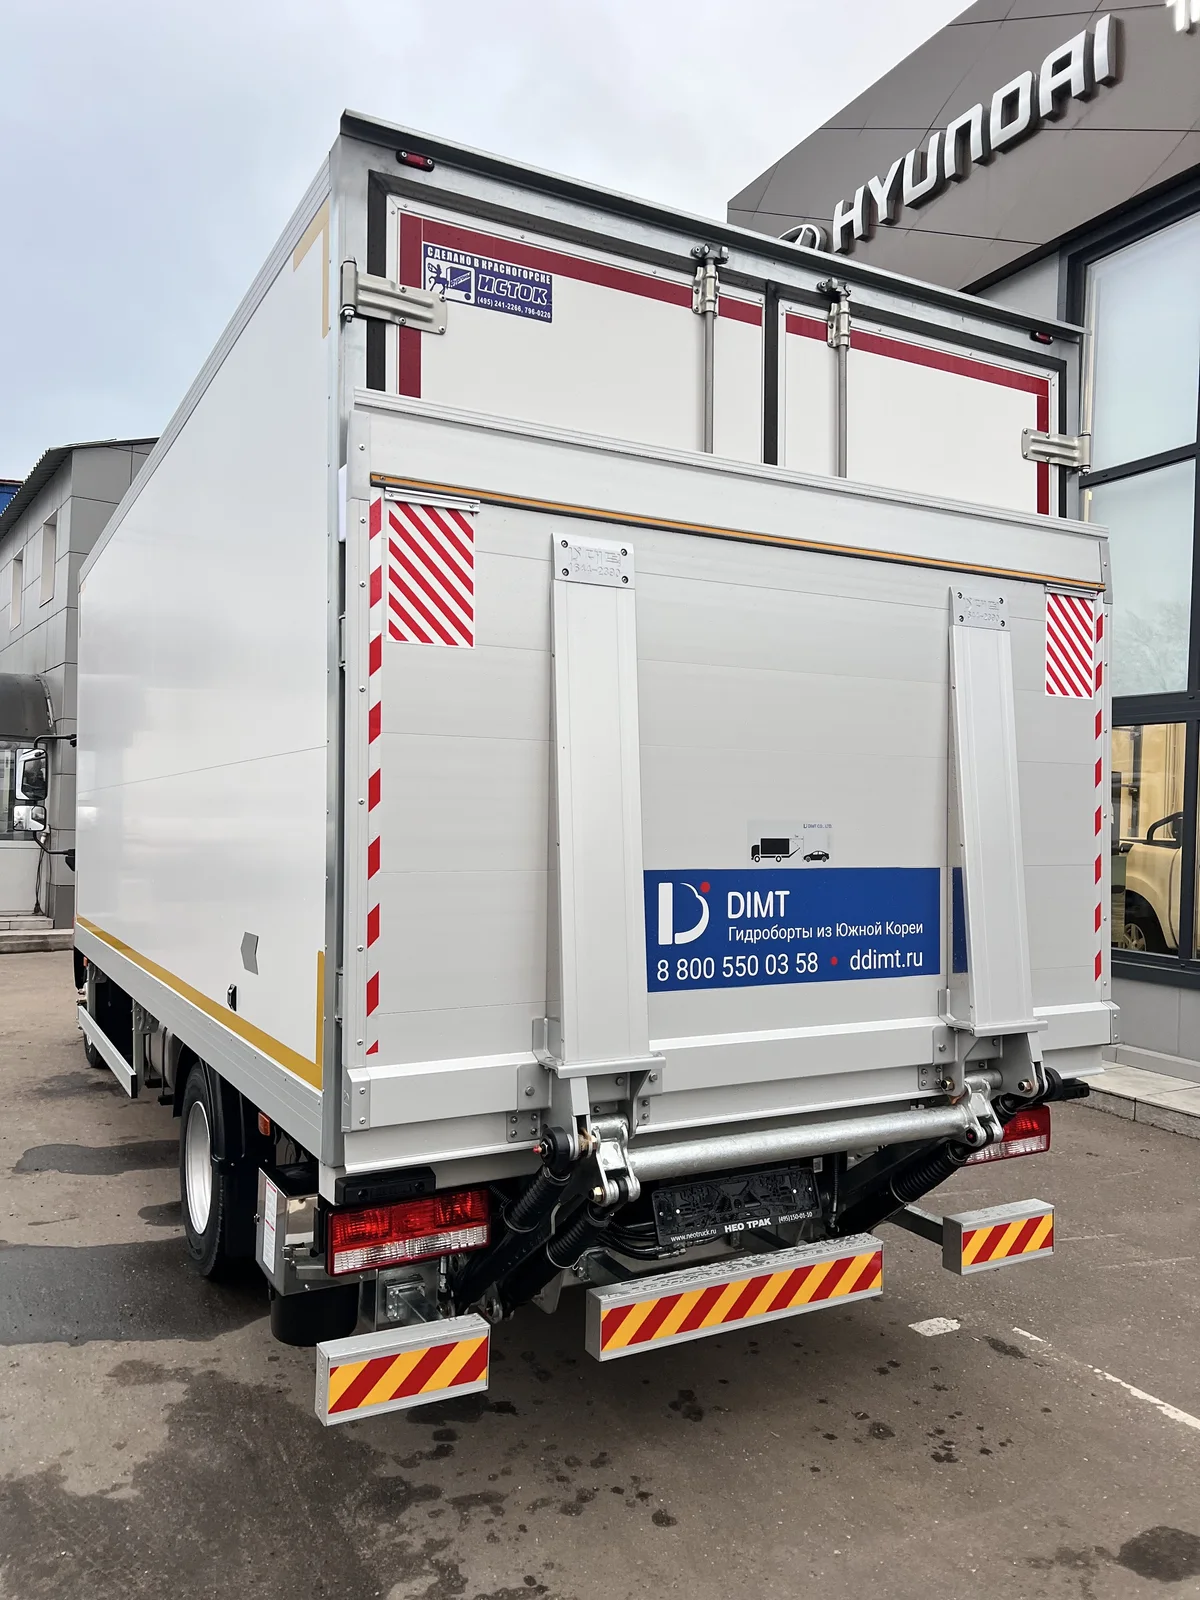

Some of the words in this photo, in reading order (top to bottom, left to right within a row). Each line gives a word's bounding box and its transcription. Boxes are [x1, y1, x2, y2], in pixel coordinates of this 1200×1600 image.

[832, 13, 1123, 254] HYUNDAI
[427, 246, 472, 266] СДЕЛАНО
[473, 258, 480, 268] В
[481, 261, 551, 285] КРАСНОГОРСКЕ
[477, 273, 548, 306] ИСТОК
[477, 296, 493, 308] (495)
[727, 890, 791, 919] DIMT
[728, 922, 813, 944] Гидроборты
[816, 926, 832, 938] из
[835, 921, 882, 938] Южной
[885, 921, 924, 938] Кореи
[656, 959, 670, 982] 8
[676, 957, 715, 980] 800
[722, 955, 759, 978] 550
[765, 954, 789, 976] 03
[795, 952, 819, 974] 58
[849, 948, 924, 971] ddimt.ru
[670, 1228, 717, 1243] www.neotruck.ru
[724, 1222, 745, 1234] НЕО
[746, 1217, 772, 1229] ТРАК
